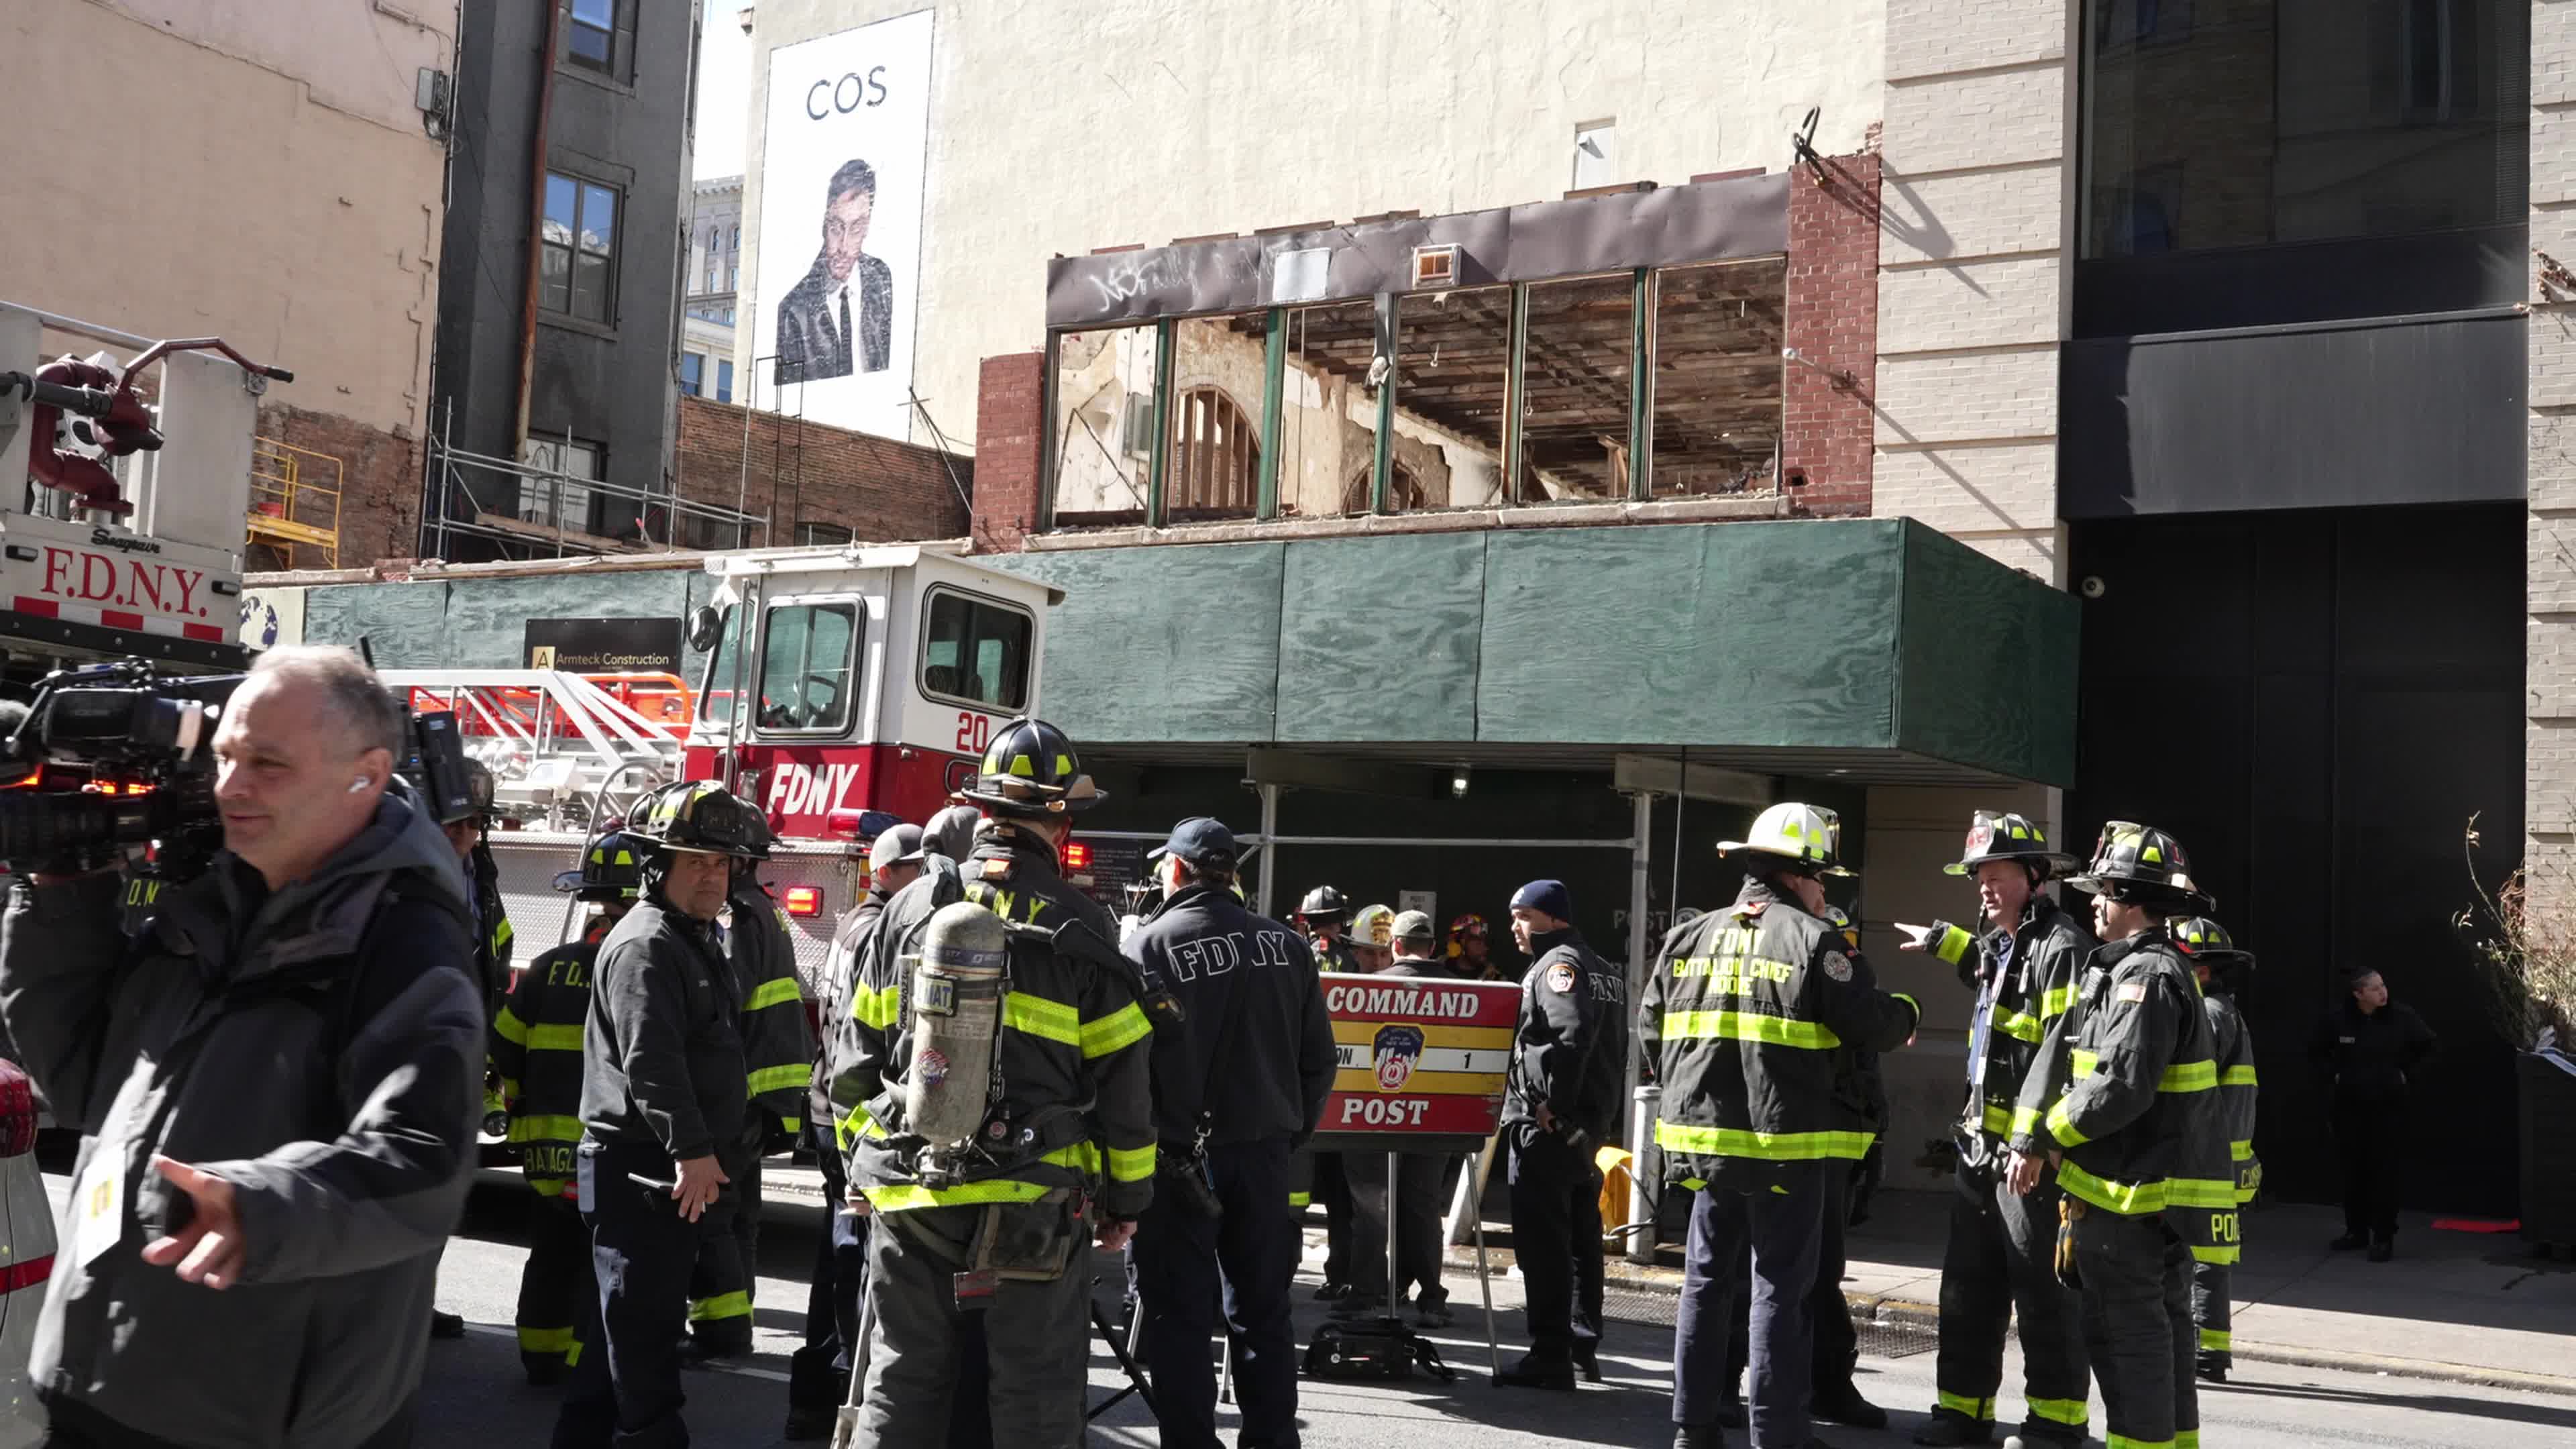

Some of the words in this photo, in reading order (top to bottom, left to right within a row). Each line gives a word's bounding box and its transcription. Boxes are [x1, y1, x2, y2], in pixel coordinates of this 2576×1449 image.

[806, 65, 886, 121] COS
[40, 546, 207, 618] F.D.N.Y.
[555, 653, 600, 665] Armteck
[603, 652, 669, 665] Construction
[956, 712, 989, 753] 20
[765, 763, 859, 815] FDNY
[1709, 928, 1766, 956] FDNY
[1749, 958, 1793, 984] CHIEF
[1326, 986, 1479, 1018] COMMAND
[1464, 1053, 1471, 1069] 1
[1342, 1098, 1429, 1125] POST
